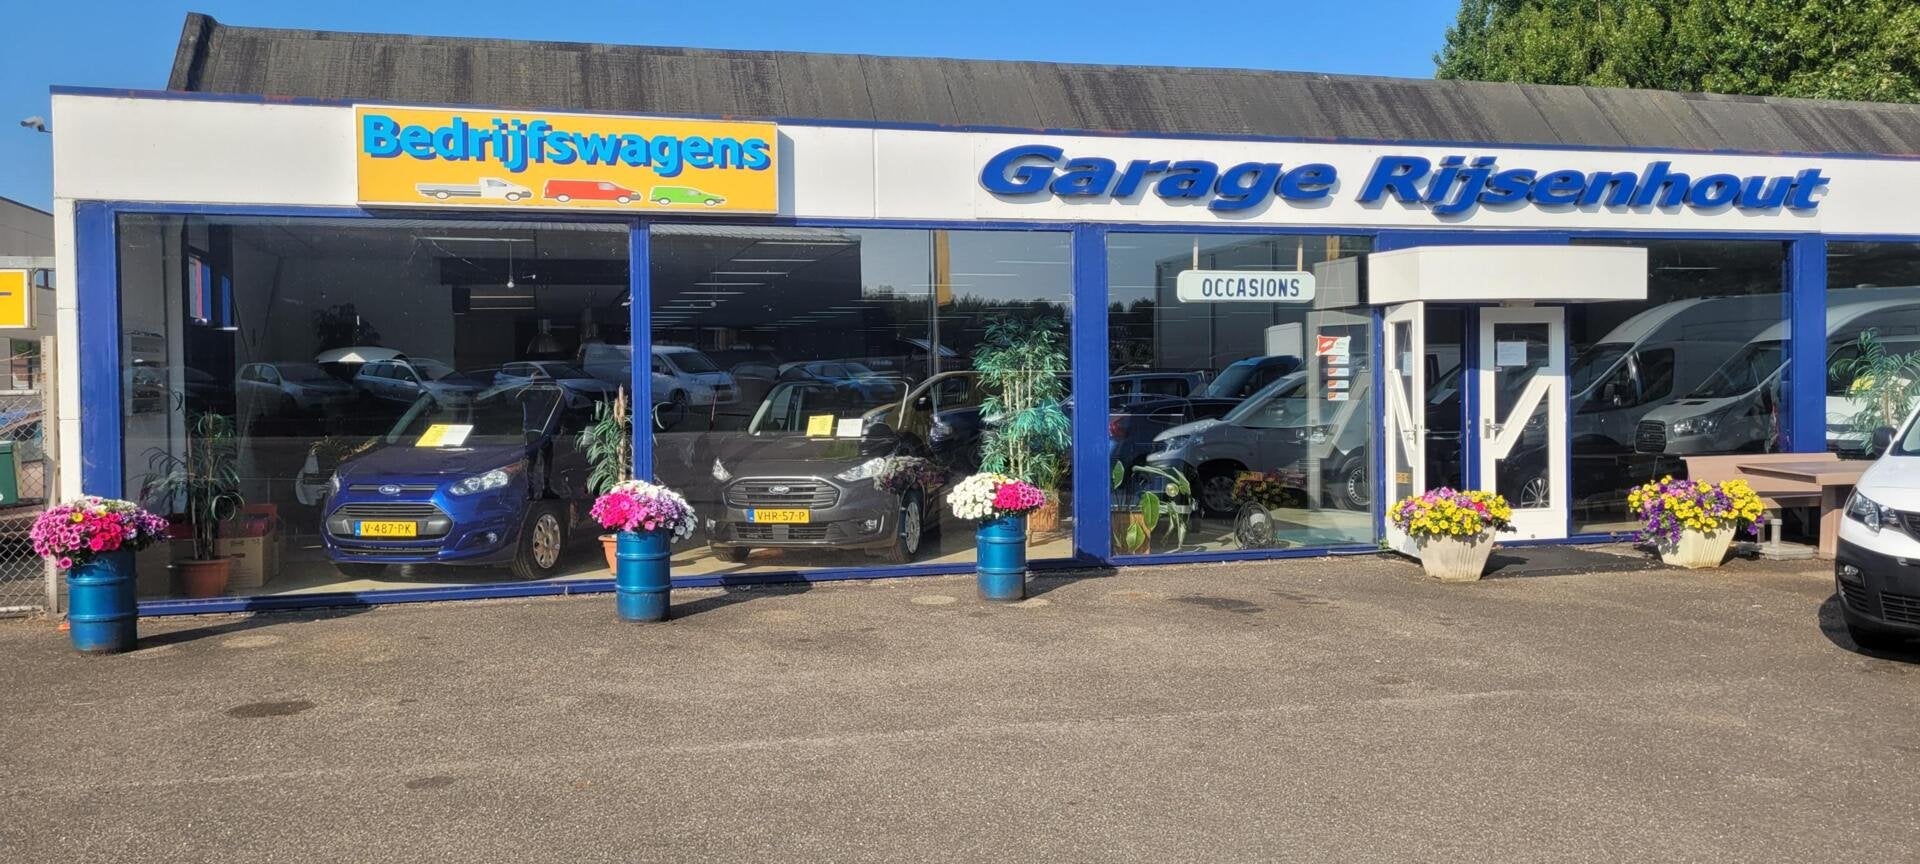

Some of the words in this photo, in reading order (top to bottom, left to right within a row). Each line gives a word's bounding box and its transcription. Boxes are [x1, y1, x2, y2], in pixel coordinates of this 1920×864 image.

[362, 114, 771, 177] Bedrijfswagens
[979, 144, 1338, 212] Garage
[1357, 155, 1830, 216] Rijsenhout
[1202, 277, 1300, 297] OCCASIONS
[757, 511, 805, 521] VHR-57-P
[364, 523, 411, 534] V-487-PK
